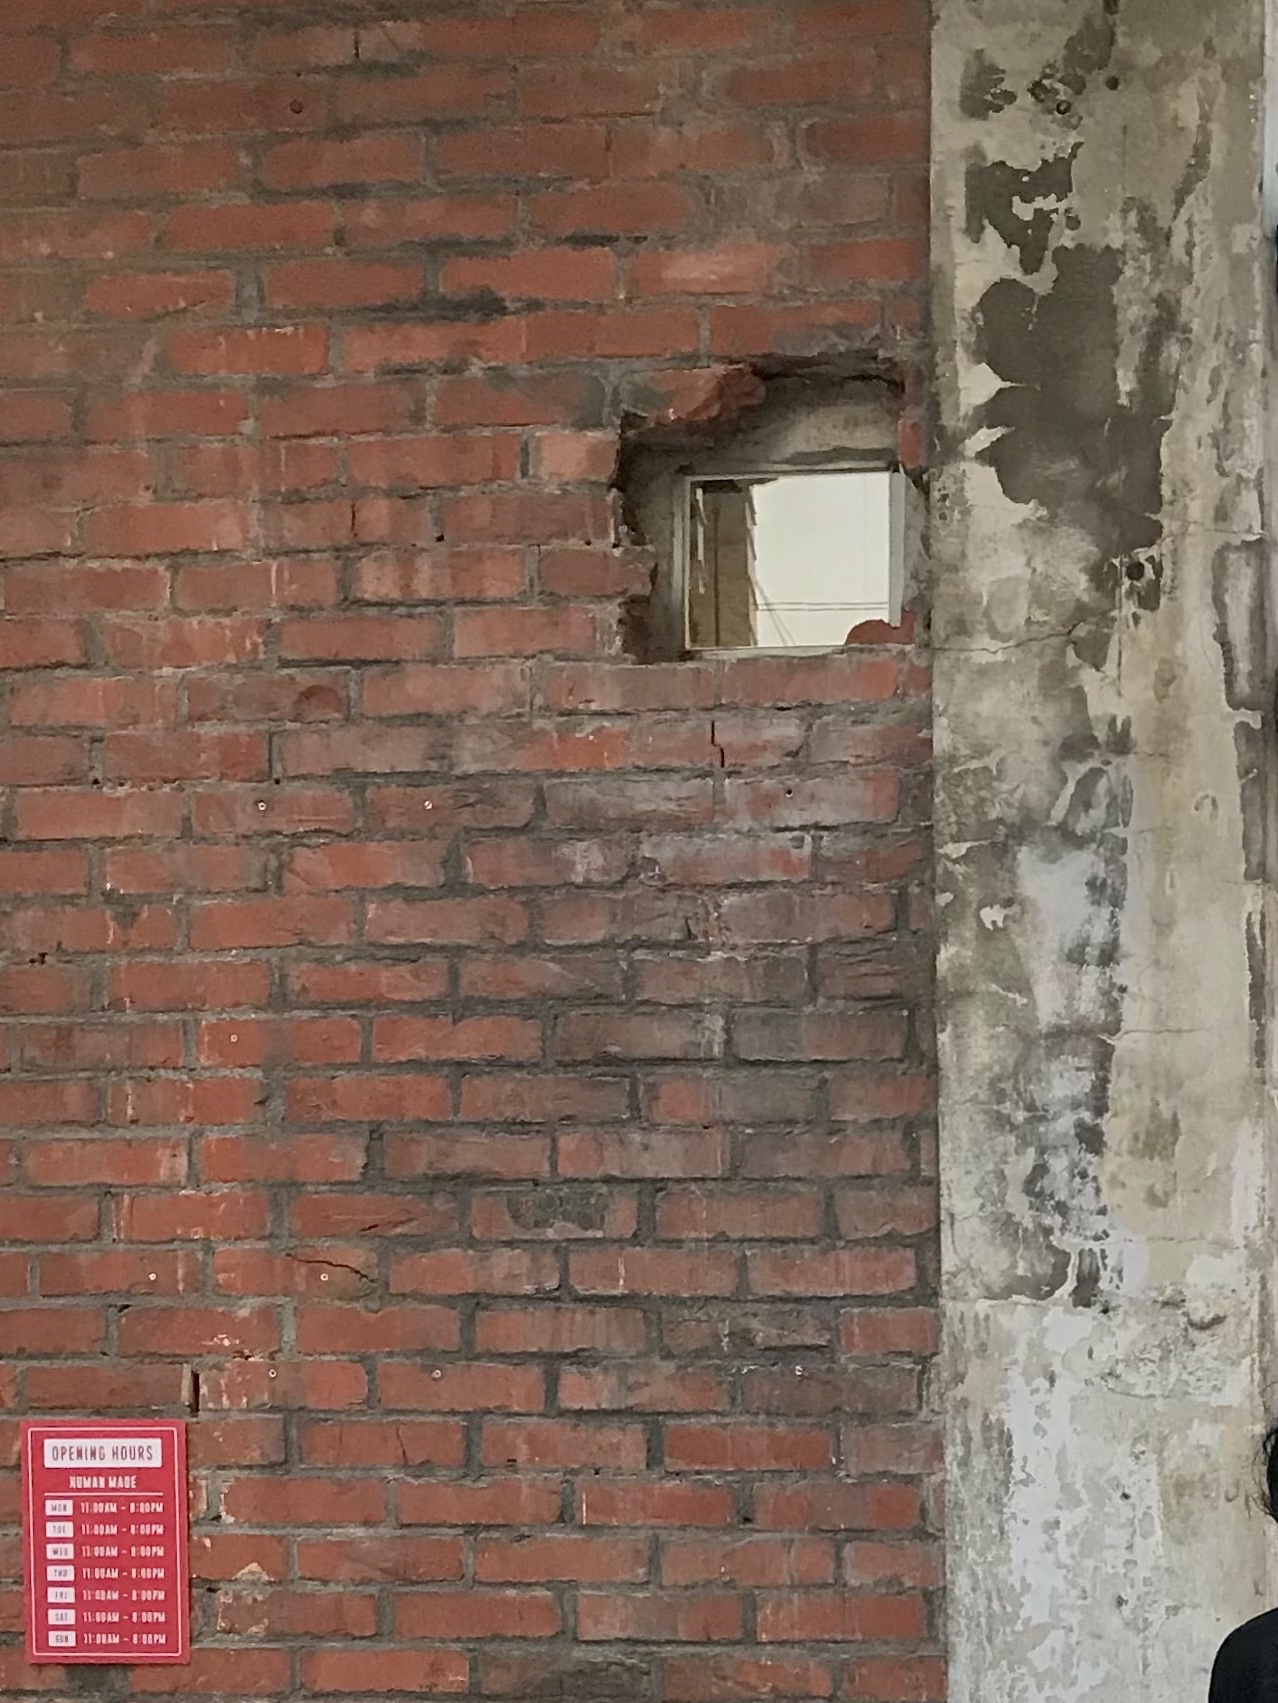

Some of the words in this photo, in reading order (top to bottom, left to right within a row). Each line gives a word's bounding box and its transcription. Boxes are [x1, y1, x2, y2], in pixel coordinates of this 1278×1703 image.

[51, 1445, 106, 1461] OPENING
[111, 1445, 154, 1461] HOURS
[69, 1475, 105, 1489] HUMAN
[108, 1475, 137, 1489] MADE
